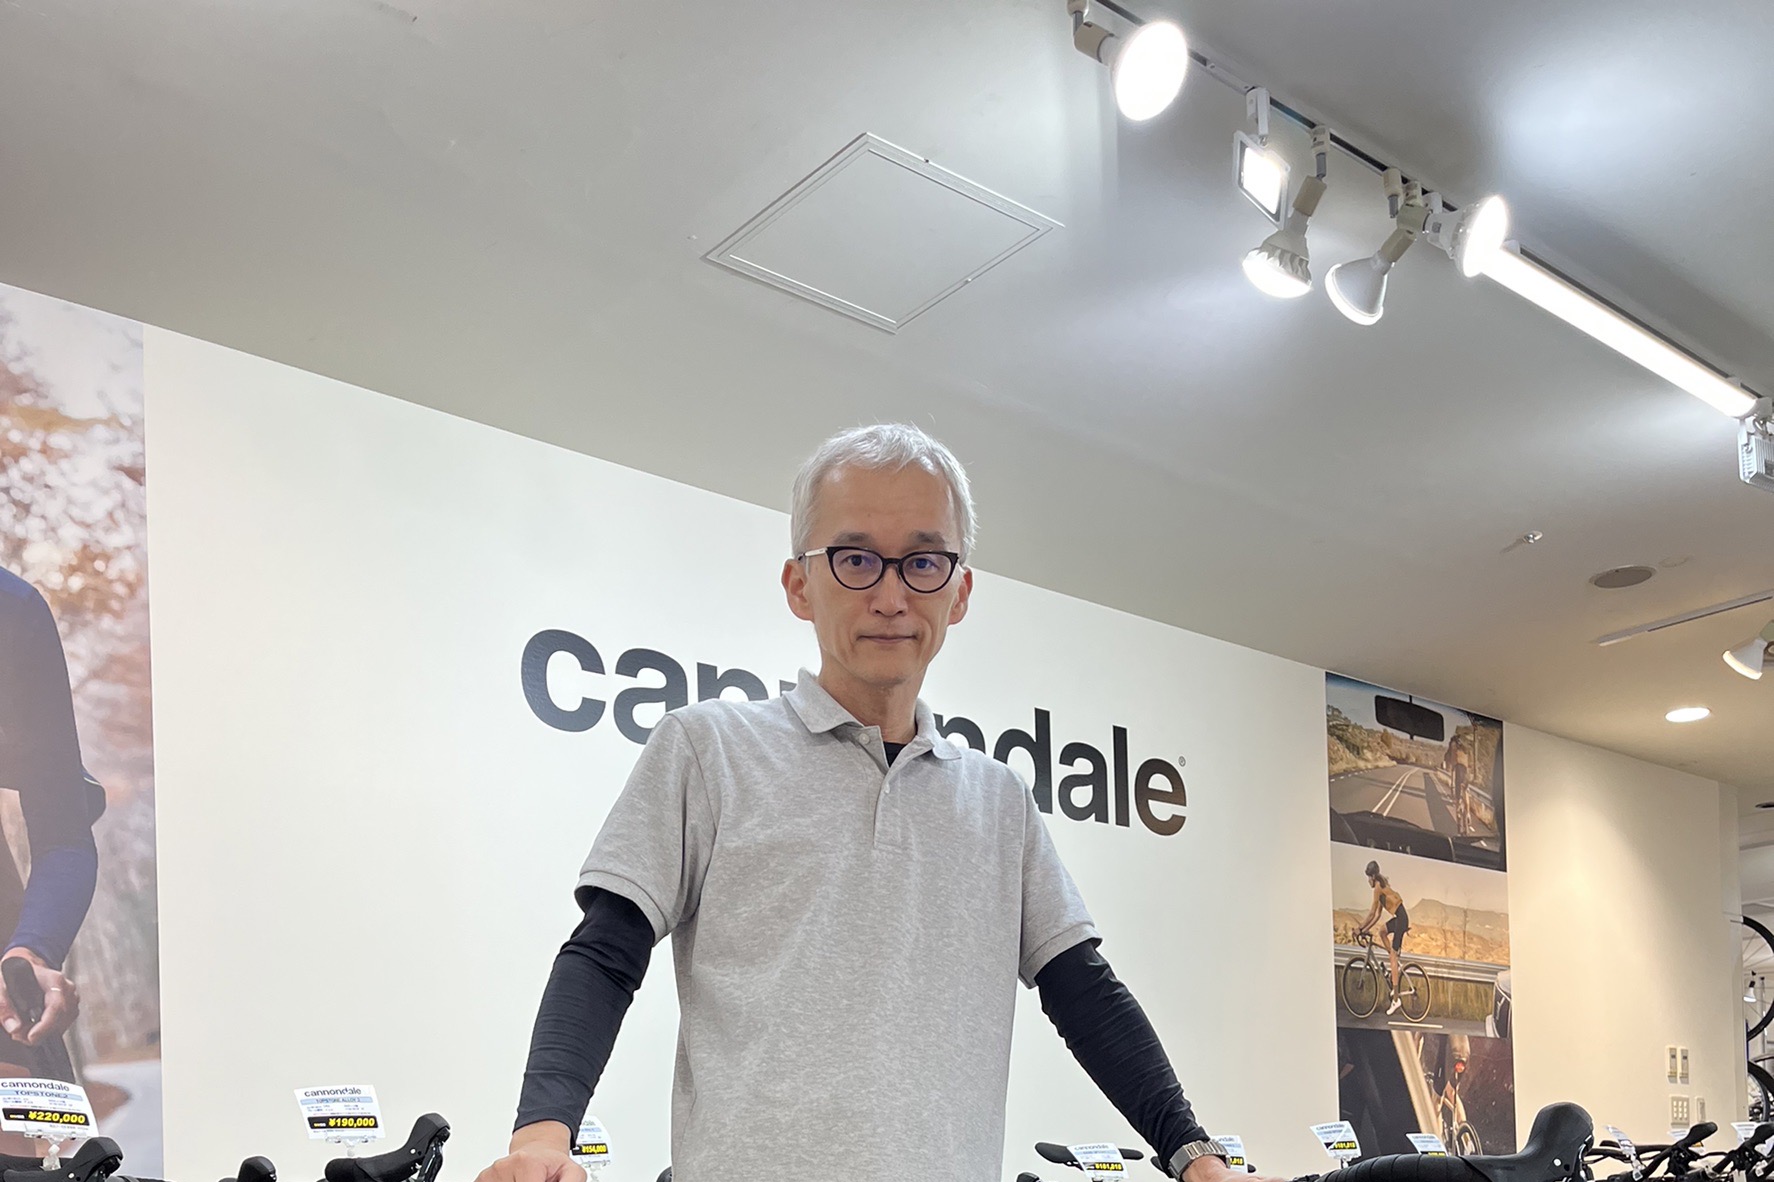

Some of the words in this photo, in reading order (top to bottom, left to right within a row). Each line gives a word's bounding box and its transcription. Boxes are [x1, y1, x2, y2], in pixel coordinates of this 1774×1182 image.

[1, 1081, 70, 1092] cannondale
[304, 1087, 362, 1097] cannondale
[28, 1111, 86, 1124] ¥220,000
[328, 1117, 376, 1128] ¥190,000
